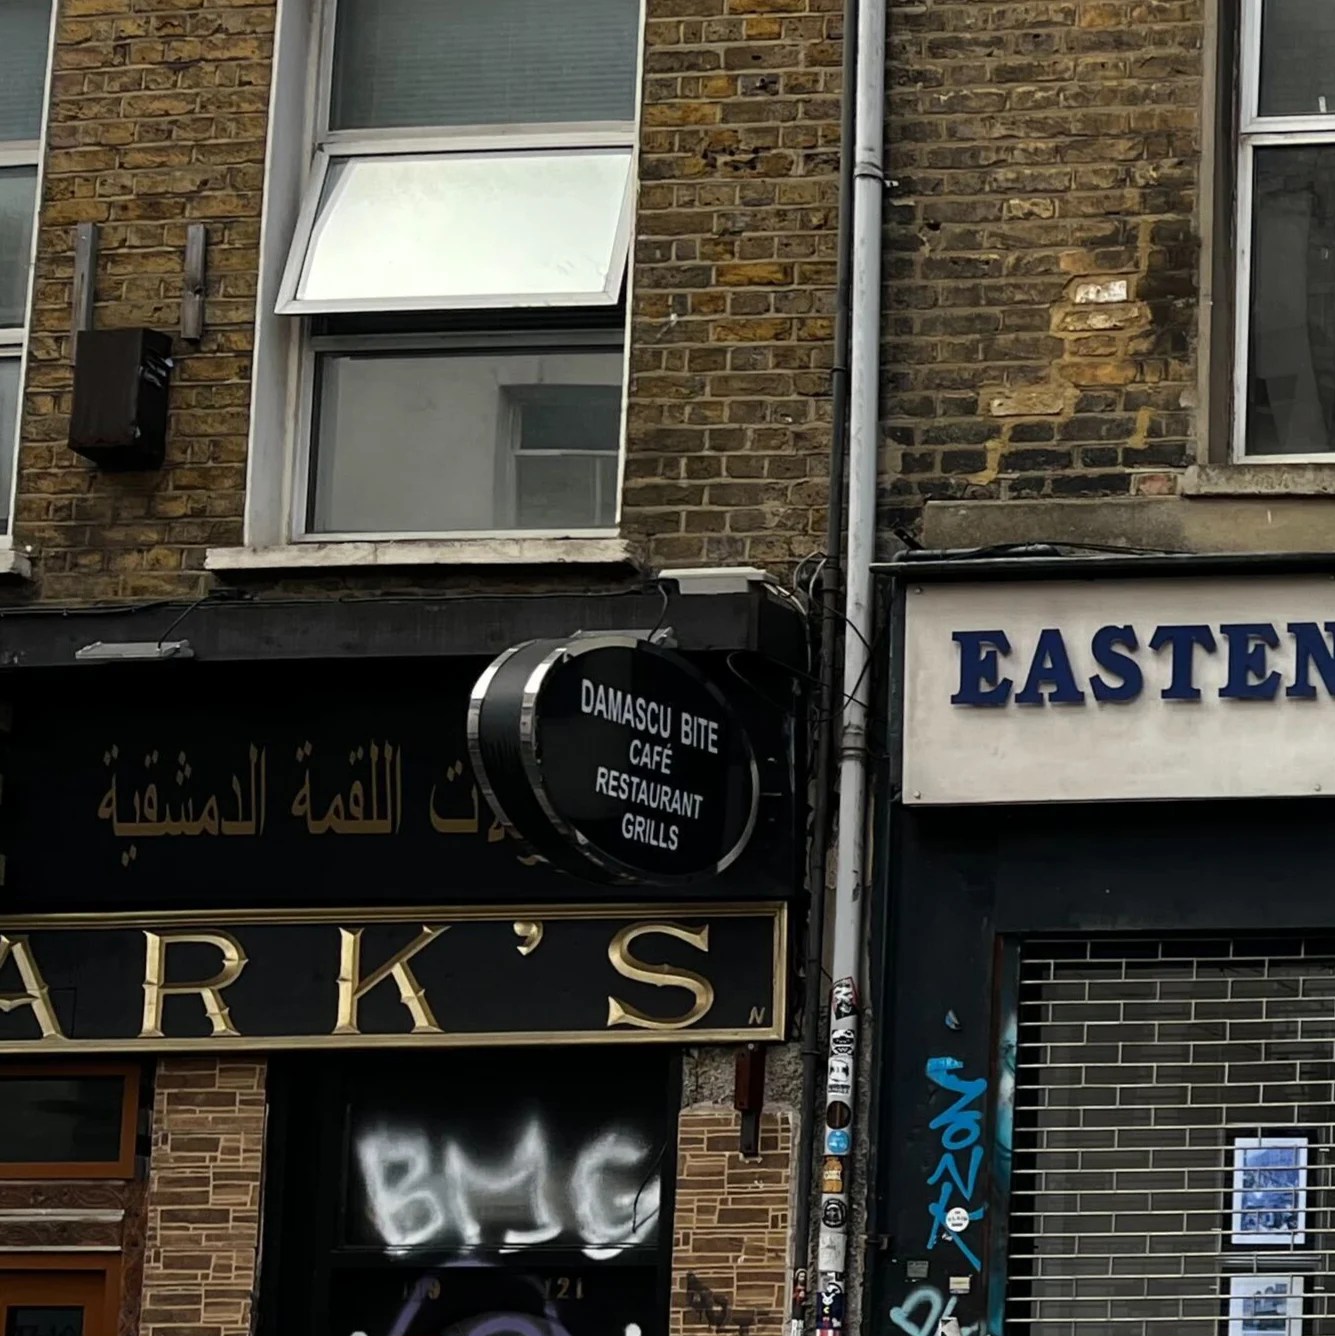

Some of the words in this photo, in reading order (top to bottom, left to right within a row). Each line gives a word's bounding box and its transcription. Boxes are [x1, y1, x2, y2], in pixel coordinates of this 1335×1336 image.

[580, 678, 673, 740] DAMASCU
[679, 710, 720, 756] BITE
[627, 737, 674, 775] CAFÉ
[594, 765, 704, 819] RESTAURANT
[620, 814, 680, 853] GRILLS
